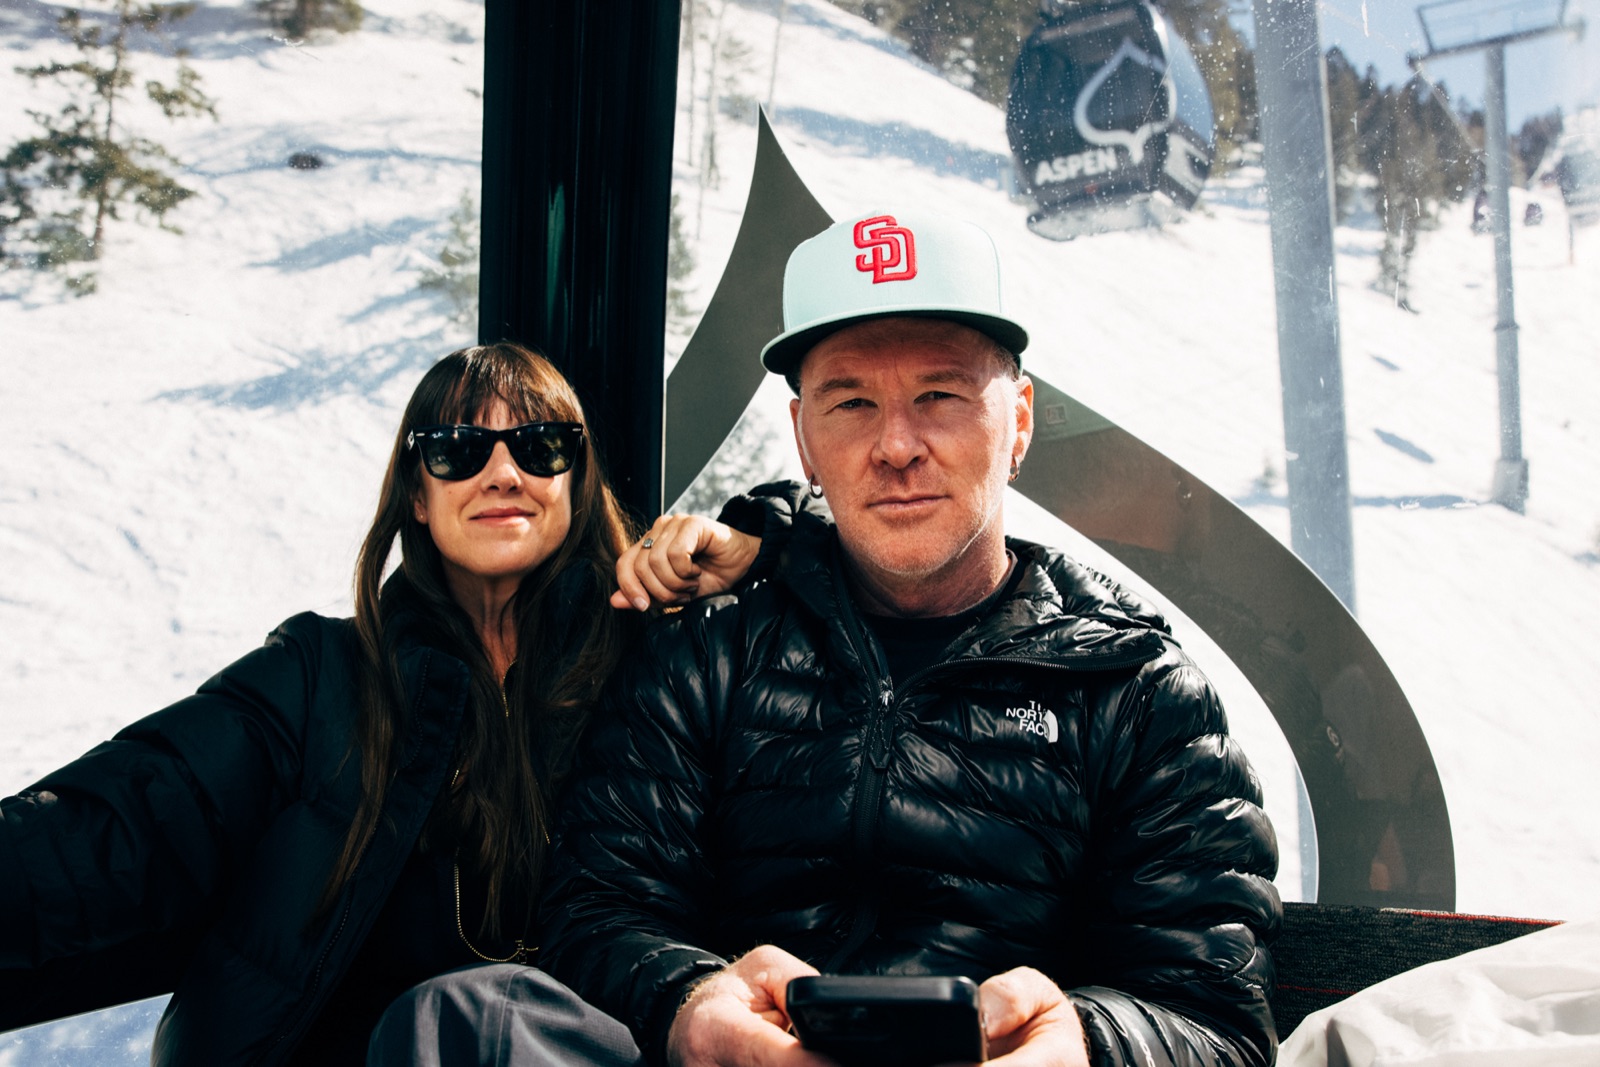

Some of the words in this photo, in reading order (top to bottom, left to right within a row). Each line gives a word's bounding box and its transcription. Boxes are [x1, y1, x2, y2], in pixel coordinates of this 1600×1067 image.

[1035, 146, 1117, 186] ASPEN
[853, 215, 917, 284] SD
[1019, 718, 1045, 736] FAC
